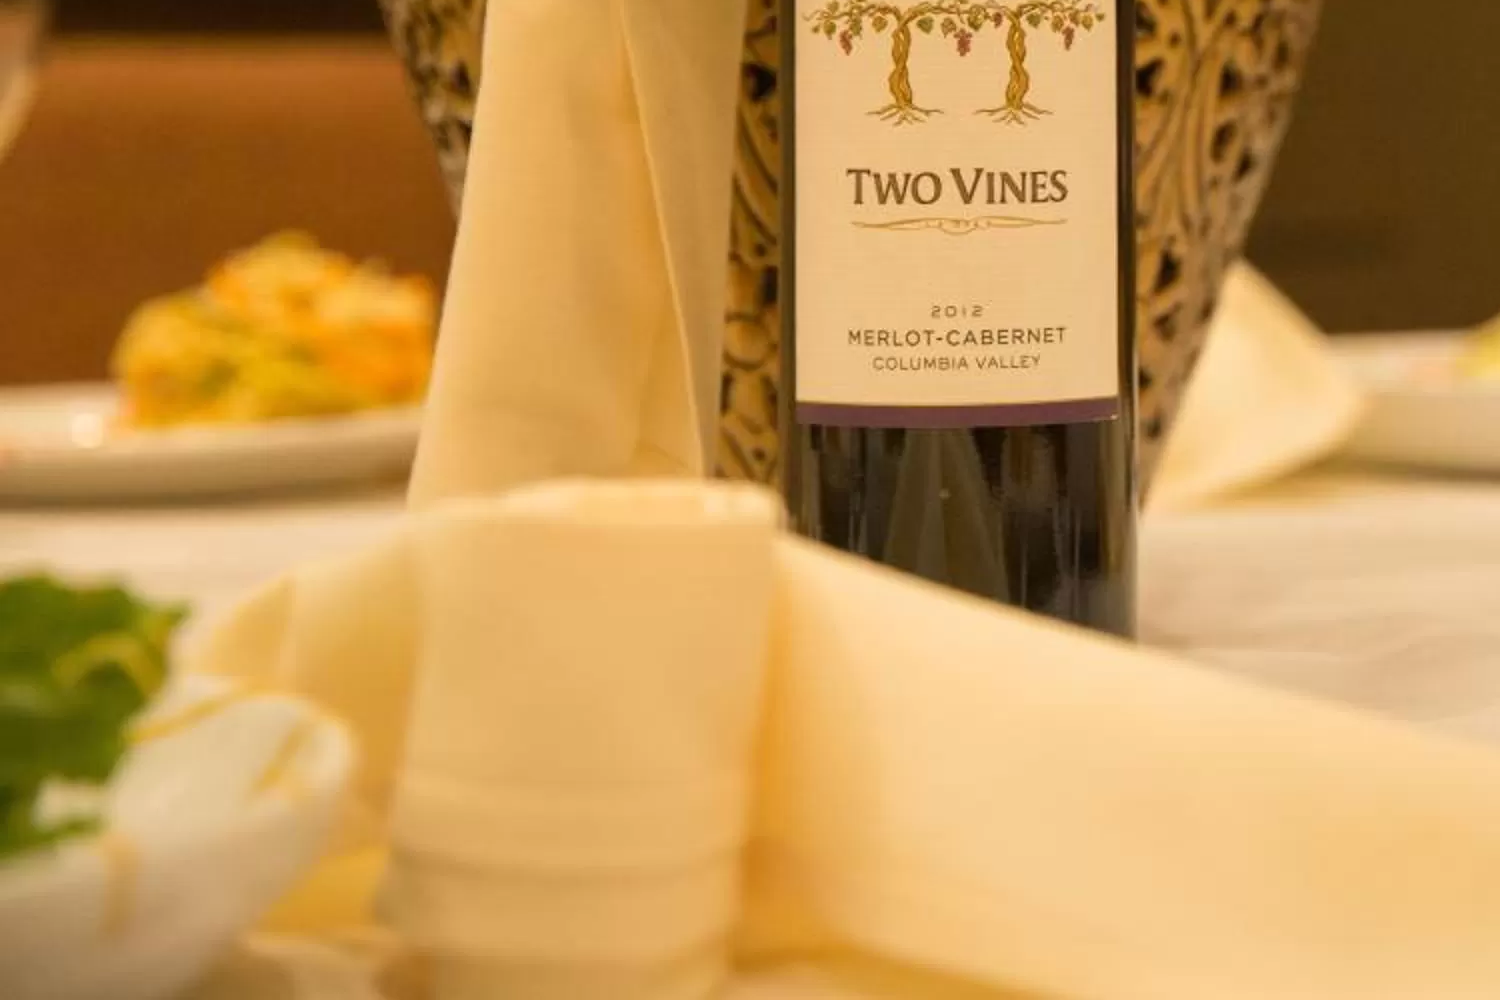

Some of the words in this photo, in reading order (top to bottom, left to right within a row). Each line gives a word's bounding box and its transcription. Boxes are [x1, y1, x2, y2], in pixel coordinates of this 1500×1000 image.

[846, 167, 942, 205] TWO
[949, 167, 1069, 205] VINES
[931, 304, 984, 319] 2012
[848, 326, 1067, 347] MERLOT-CABERNET
[873, 356, 969, 372] COLUMBIA
[975, 354, 1041, 371] VALLEY
